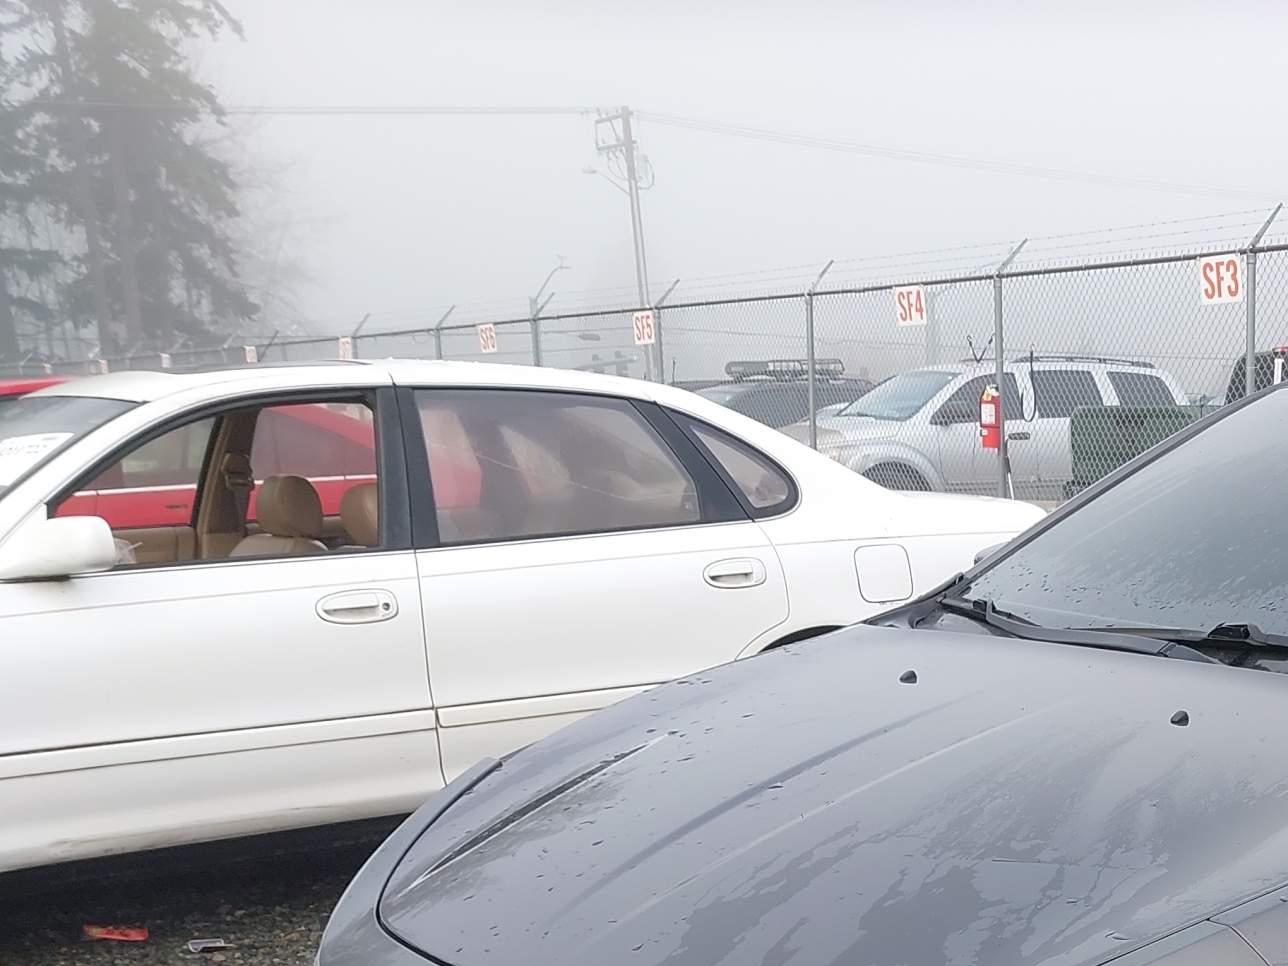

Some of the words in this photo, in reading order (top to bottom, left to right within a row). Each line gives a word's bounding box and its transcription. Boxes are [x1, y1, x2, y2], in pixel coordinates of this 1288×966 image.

[1202, 259, 1239, 300] SF3
[897, 289, 924, 322] SF4
[635, 315, 653, 341] SF5
